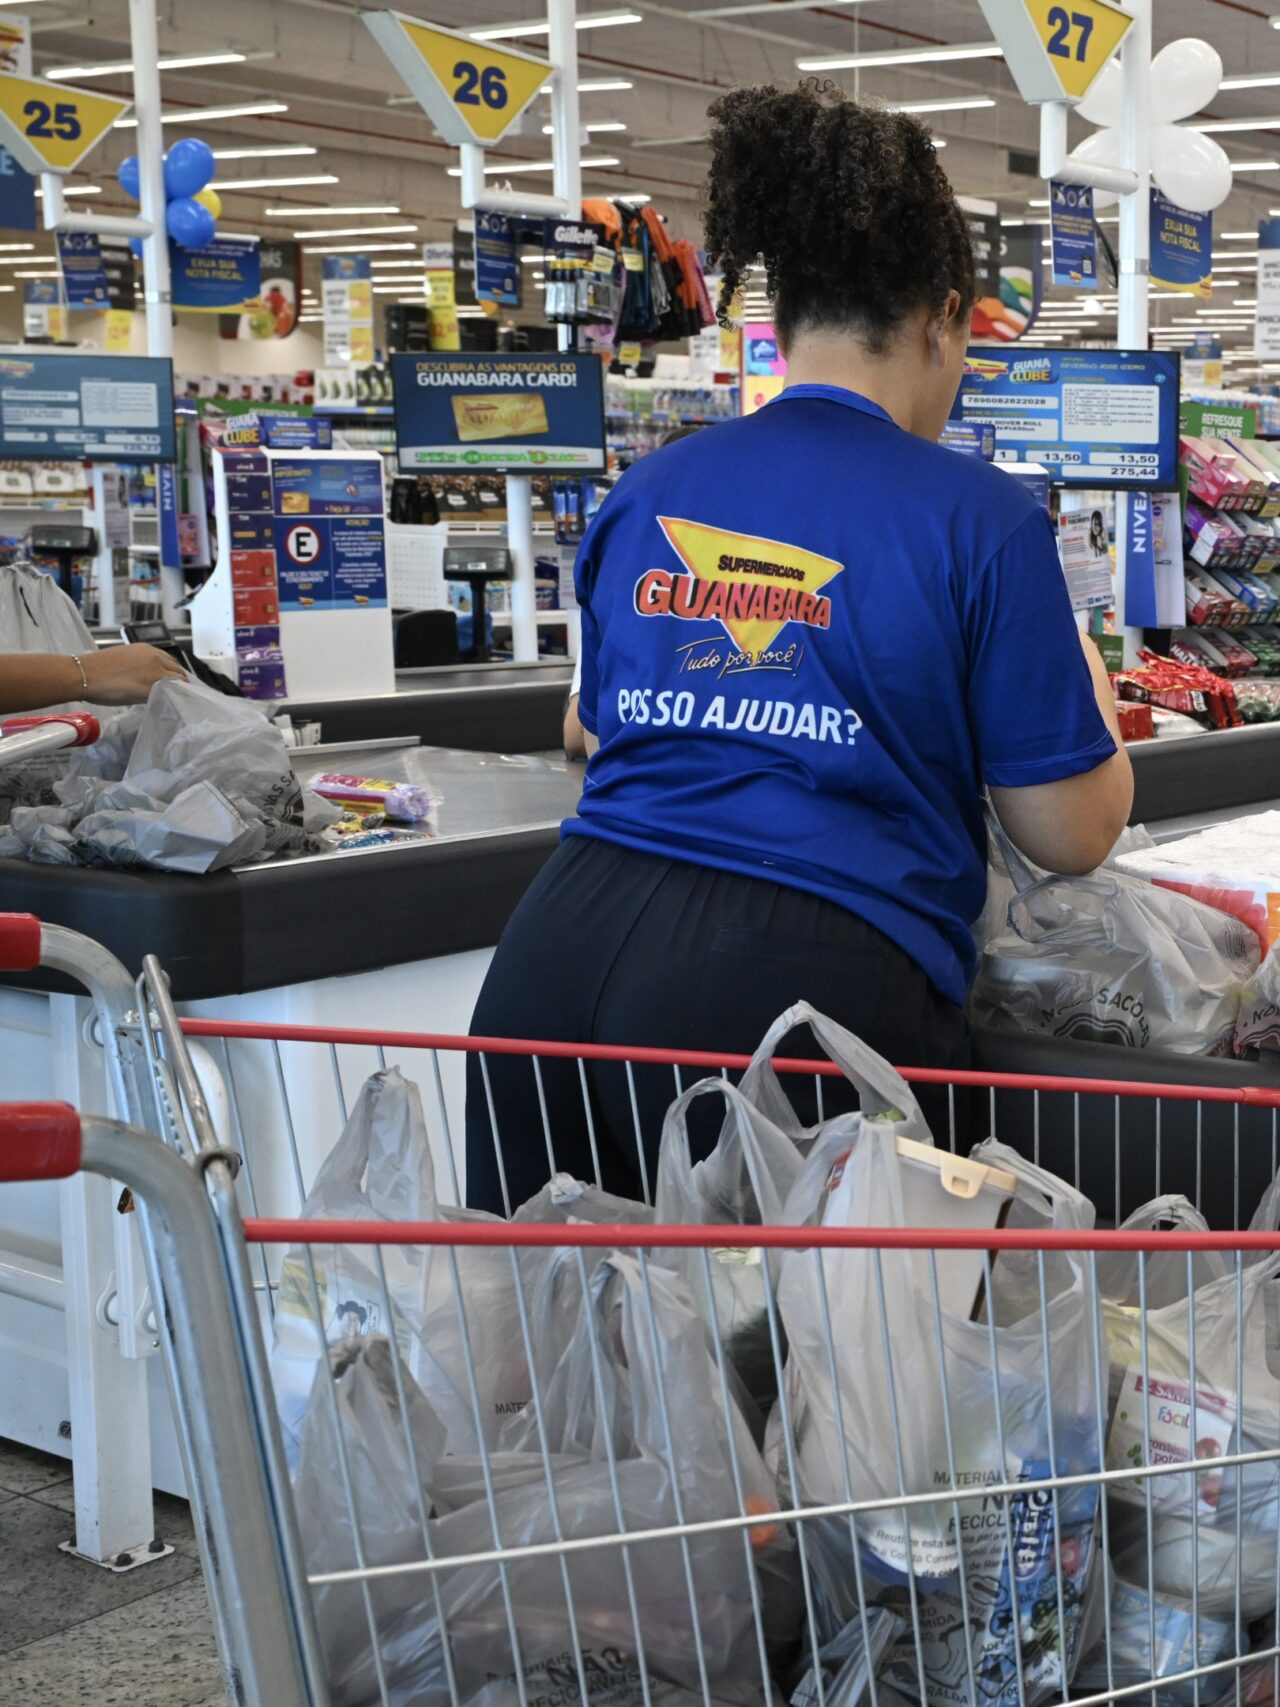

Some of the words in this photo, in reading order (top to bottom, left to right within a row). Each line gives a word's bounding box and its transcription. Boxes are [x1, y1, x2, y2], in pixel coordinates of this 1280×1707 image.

[1047, 6, 1093, 62] 27
[453, 61, 508, 109] 26
[23, 100, 81, 140] 25
[555, 226, 598, 245] Gillette
[416, 363, 476, 372] DESCUBRA
[477, 363, 491, 372] AS
[494, 363, 558, 372] VANTAGENS
[560, 363, 576, 372] DO
[1013, 358, 1051, 371] GUANA
[417, 373, 523, 387] GUANABARA
[526, 373, 577, 387] CARD!
[1010, 370, 1050, 383] CLUBE
[1202, 413, 1243, 428] REFRESQUE
[1202, 426, 1215, 438] SUA
[1216, 427, 1243, 439] MENTE
[1043, 453, 1080, 462] 13,50
[1119, 455, 1156, 464] 13,50
[1110, 468, 1156, 477] 275,44
[163, 464, 172, 511] NIVE
[296, 532, 312, 557] E
[718, 555, 805, 582] SUPERMERCADOS
[636, 569, 831, 629] GUANABARA
[676, 636, 726, 673] Tudo
[717, 651, 753, 680] por
[618, 689, 695, 727] POSSO
[701, 695, 863, 745] AJUDAR?
